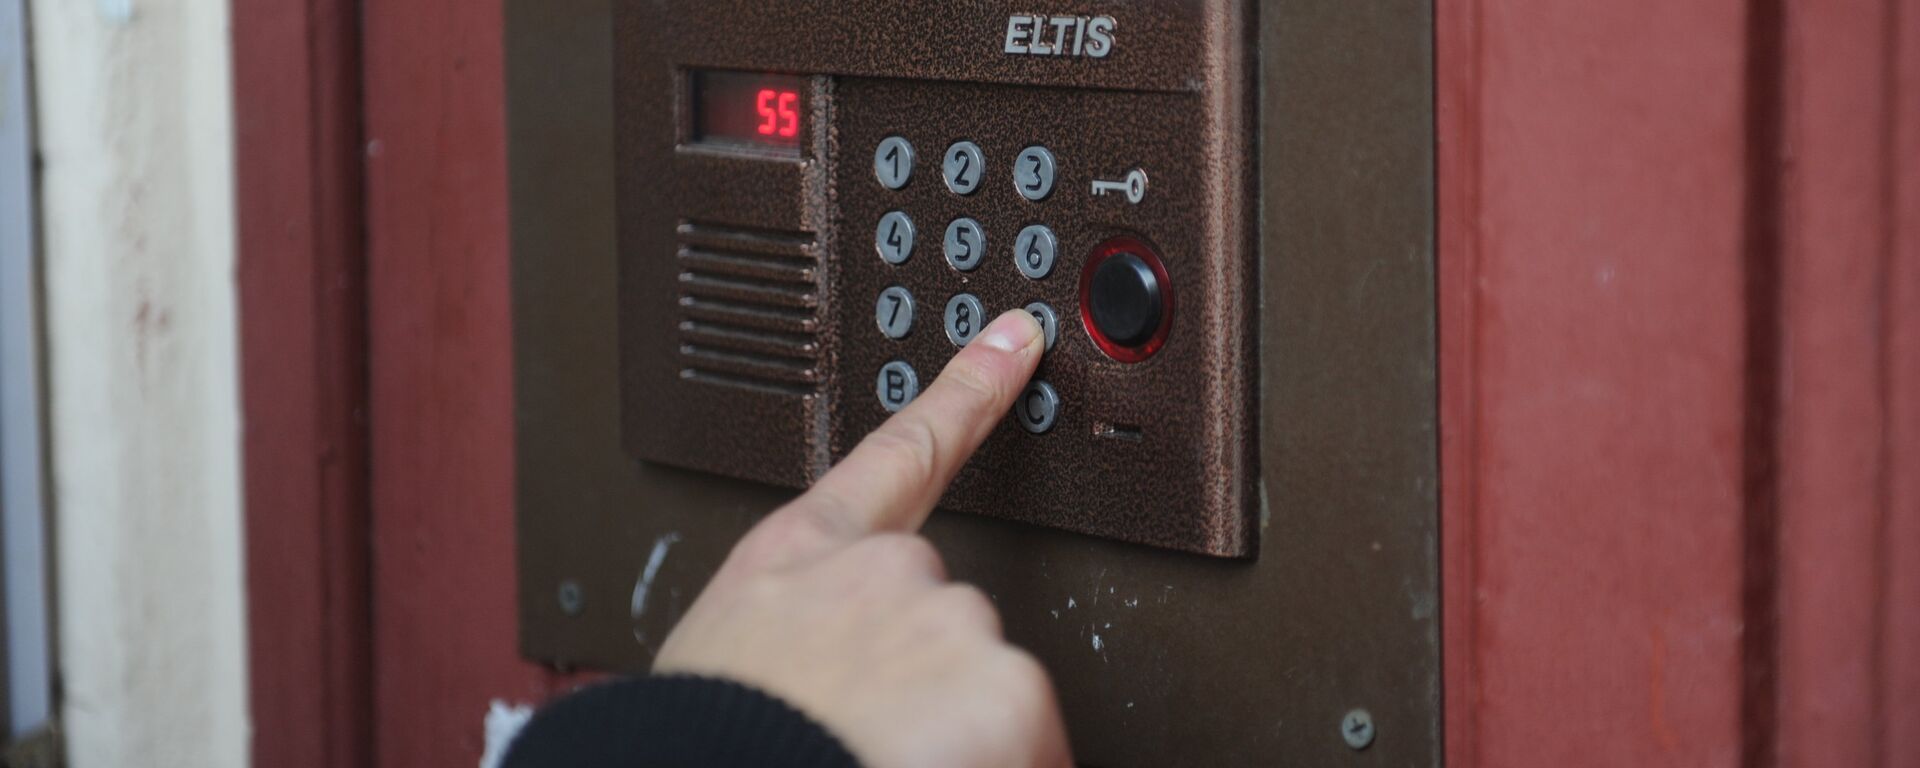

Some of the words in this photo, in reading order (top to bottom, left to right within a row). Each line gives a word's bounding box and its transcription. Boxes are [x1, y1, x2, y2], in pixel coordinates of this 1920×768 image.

[1004, 14, 1115, 58] ELTIS
[757, 89, 798, 137] 55
[884, 145, 899, 181] 1
[953, 150, 970, 186] 2
[1025, 155, 1042, 191] 3
[886, 220, 902, 256] 4
[954, 226, 971, 262] 5
[1026, 233, 1043, 270] 6
[887, 294, 901, 328] 7
[954, 302, 971, 338] 8
[886, 370, 905, 404] B
[1024, 388, 1045, 425] C
